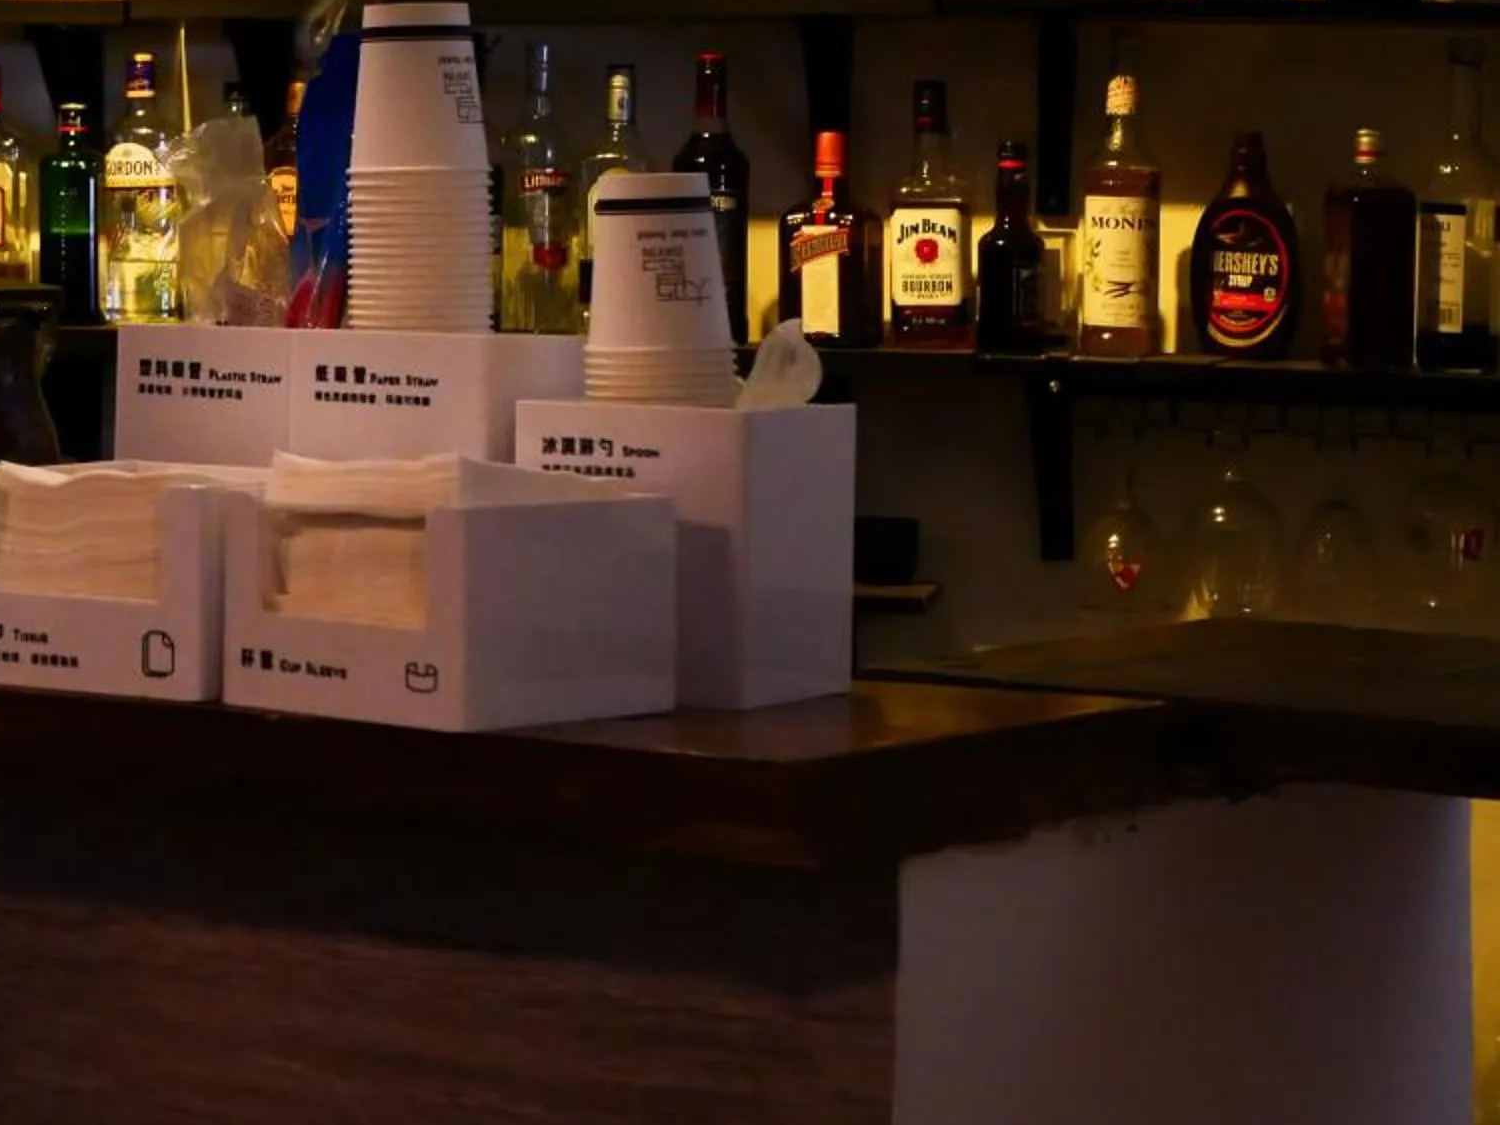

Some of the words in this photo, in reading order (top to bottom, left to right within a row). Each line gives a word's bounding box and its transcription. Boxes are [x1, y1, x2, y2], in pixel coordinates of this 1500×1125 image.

[897, 222, 920, 244] JIM
[921, 218, 957, 244] BEAM
[902, 280, 953, 293] BOURBON
